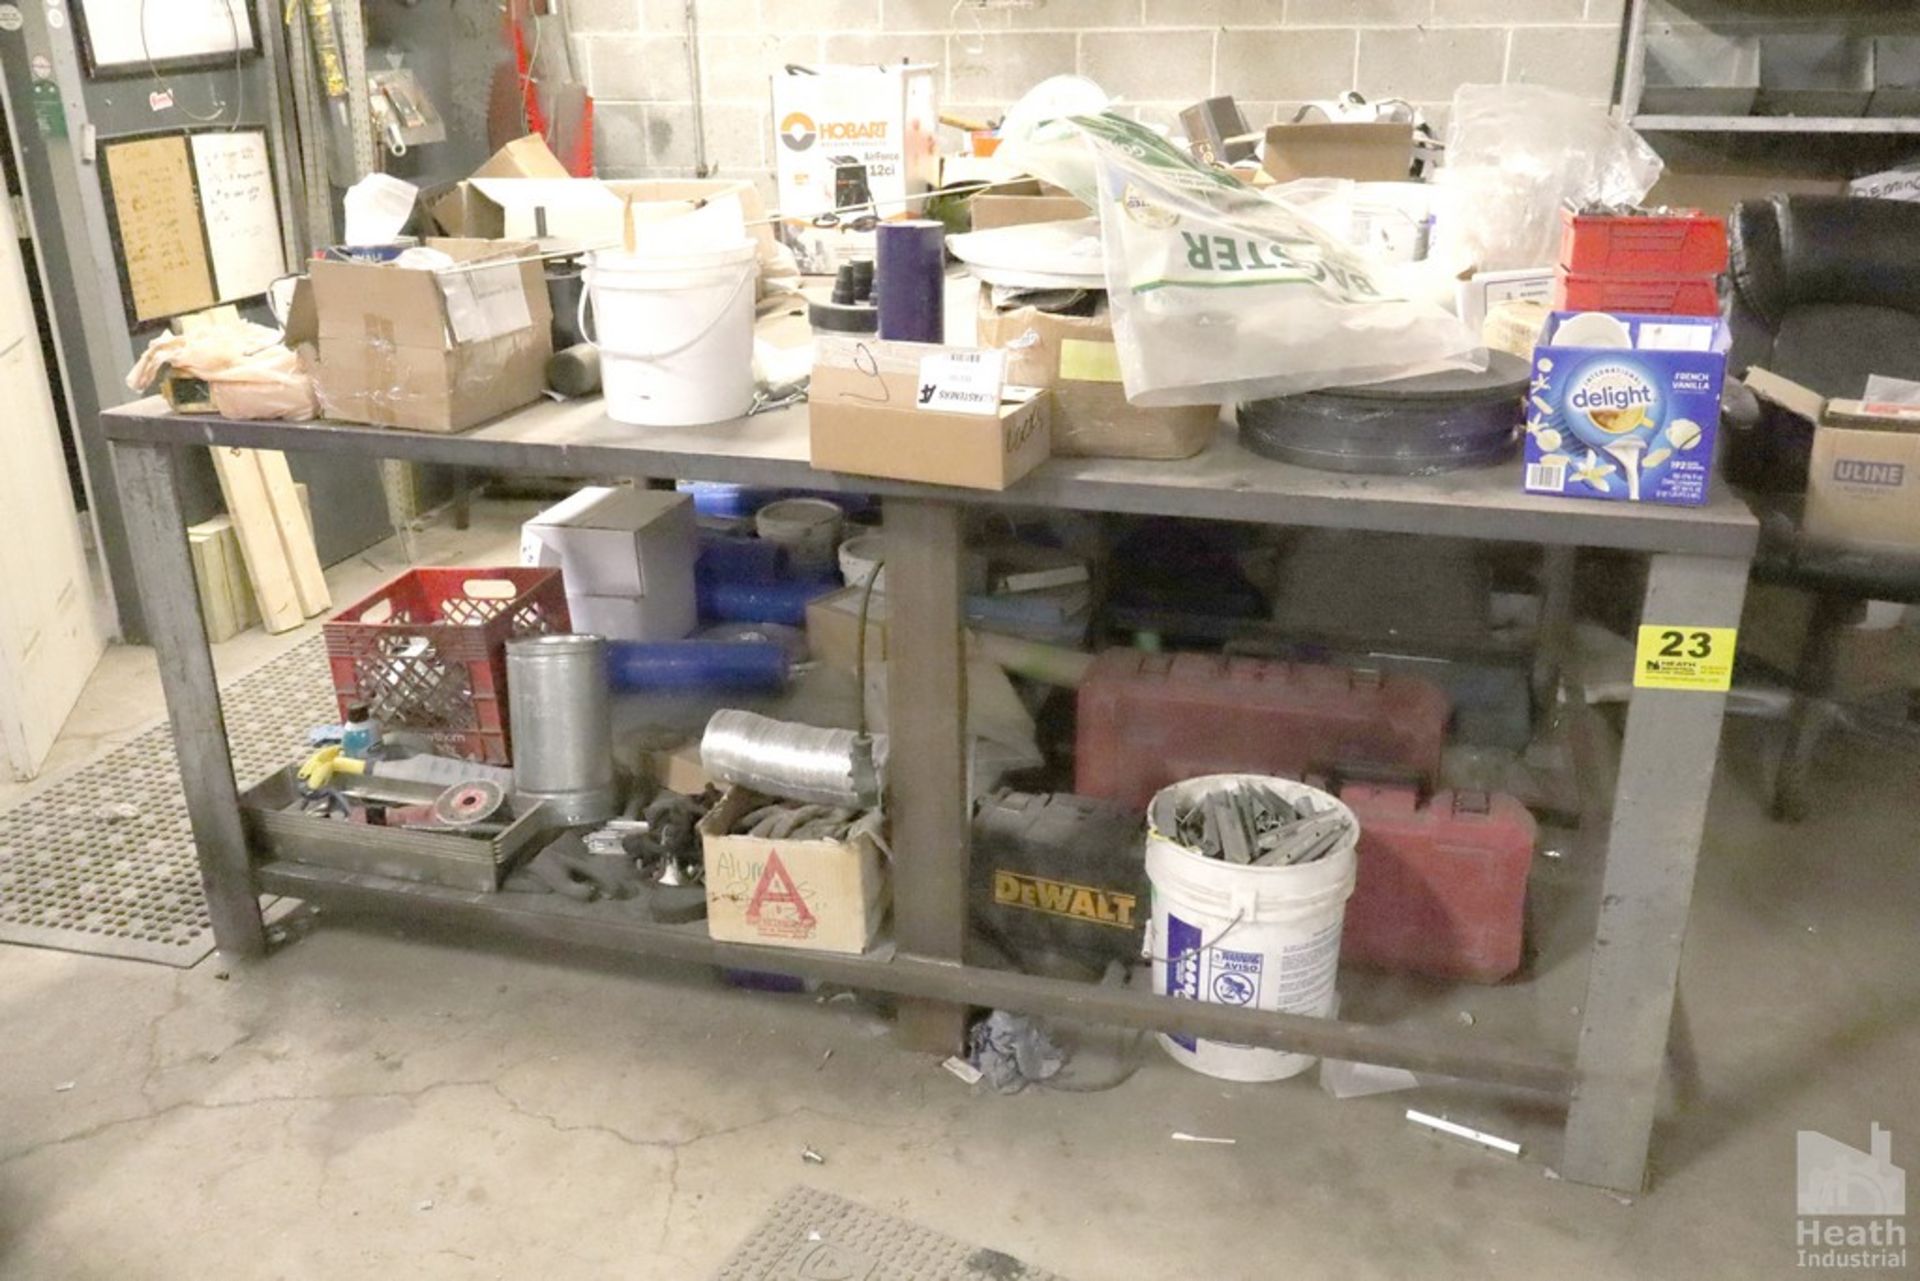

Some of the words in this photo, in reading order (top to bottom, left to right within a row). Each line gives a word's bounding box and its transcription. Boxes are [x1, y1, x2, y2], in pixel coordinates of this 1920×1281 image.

[820, 121, 888, 139] HOBART
[869, 164, 896, 177] 12ci
[1672, 381, 1710, 390] VANILLA
[1572, 385, 1651, 410] delight
[1836, 462, 1901, 484] ULINE
[1658, 630, 1712, 658] 23
[1223, 962, 1258, 972] AVISO
